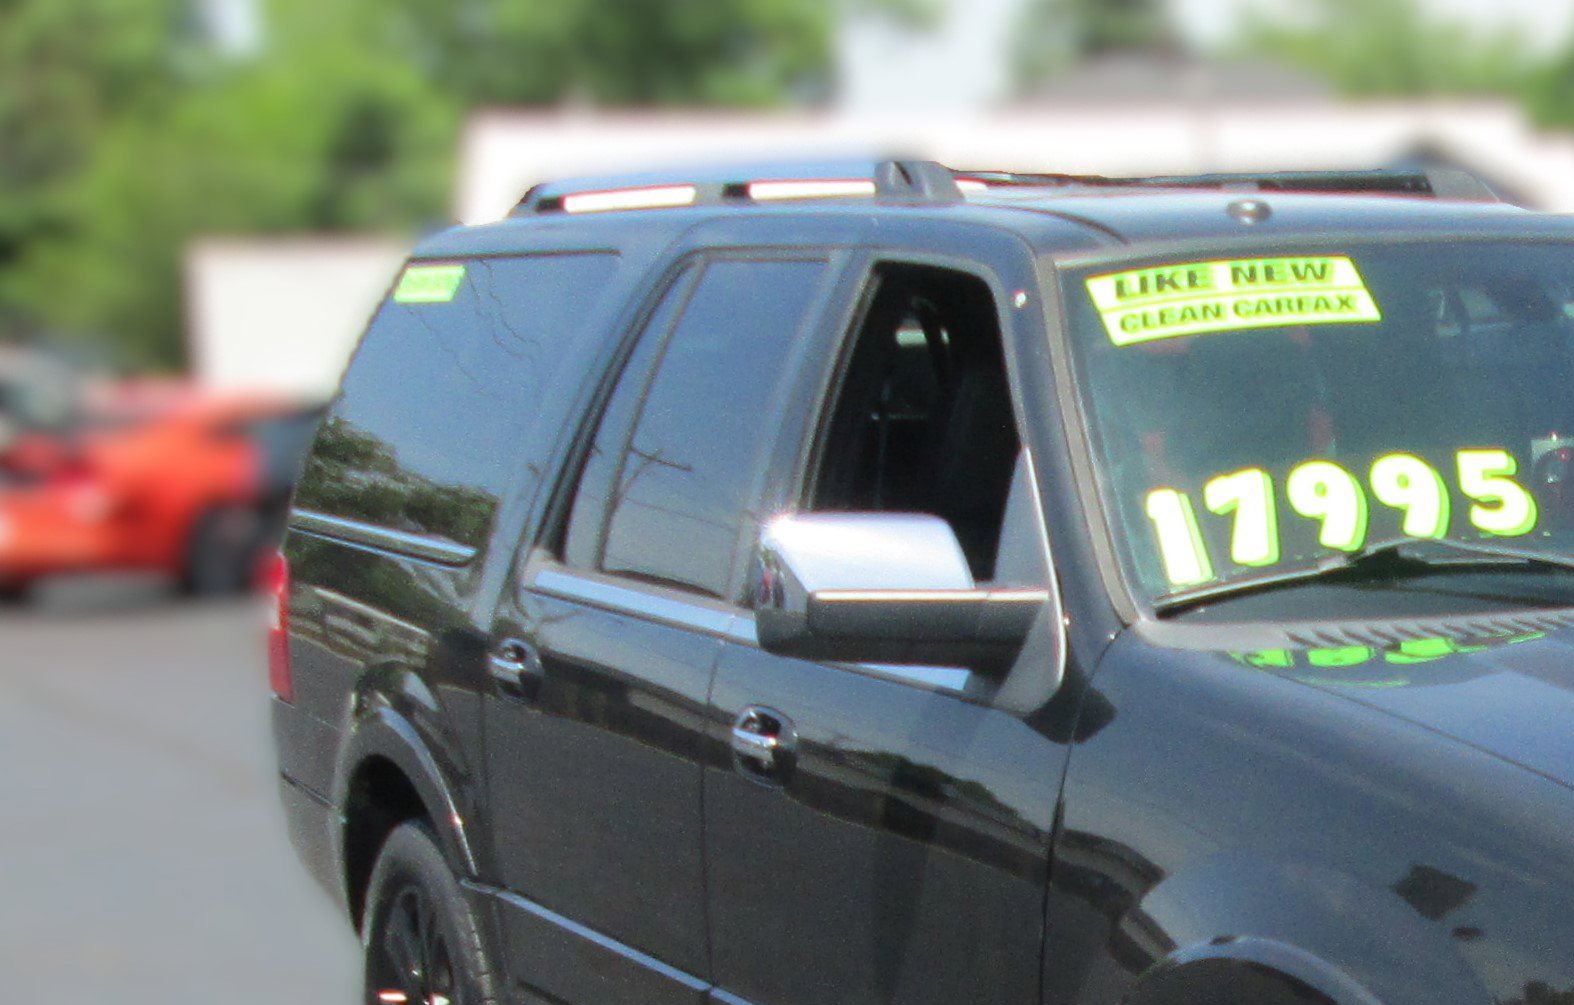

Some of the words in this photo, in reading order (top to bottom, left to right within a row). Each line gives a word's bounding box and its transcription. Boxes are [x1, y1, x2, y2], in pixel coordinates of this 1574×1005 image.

[1114, 266, 1213, 299] LIKE
[1230, 260, 1332, 287] NEW
[1119, 302, 1223, 334] CLEAN
[1232, 294, 1356, 318] CARFAX
[1145, 448, 1538, 586] 17995
